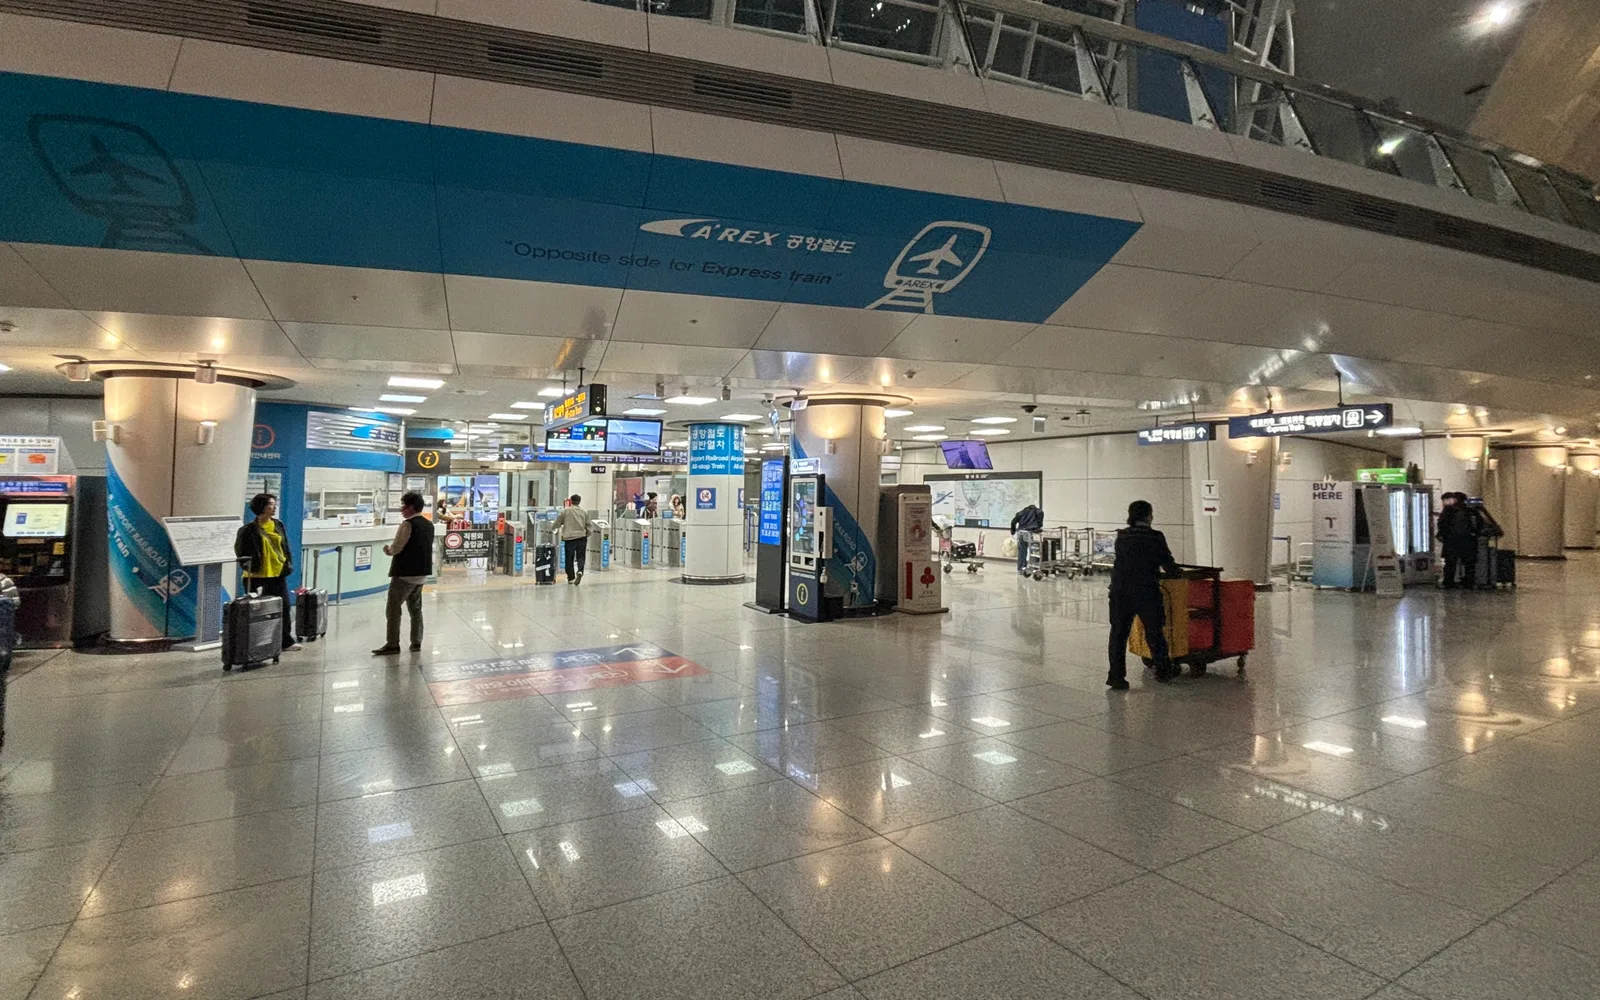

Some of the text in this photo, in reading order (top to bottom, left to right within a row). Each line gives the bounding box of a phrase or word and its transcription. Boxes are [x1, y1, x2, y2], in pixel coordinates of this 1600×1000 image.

[786, 235, 856, 254] 공항철도
[618, 255, 661, 268] side
[669, 258, 694, 271] for
[701, 261, 782, 281] Express
[903, 279, 937, 289] AREX
[692, 428, 725, 439] 공항철도
[692, 440, 725, 450] 일반열차
[1205, 484, 1215, 494] T
[1312, 483, 1336, 491] BUY
[1312, 492, 1343, 500] HERE
[1325, 516, 1337, 528] T
[113, 504, 169, 568] AIRPORT RAILROAD
[113, 531, 130, 558] Train
[463, 540, 490, 549] 출입금지
